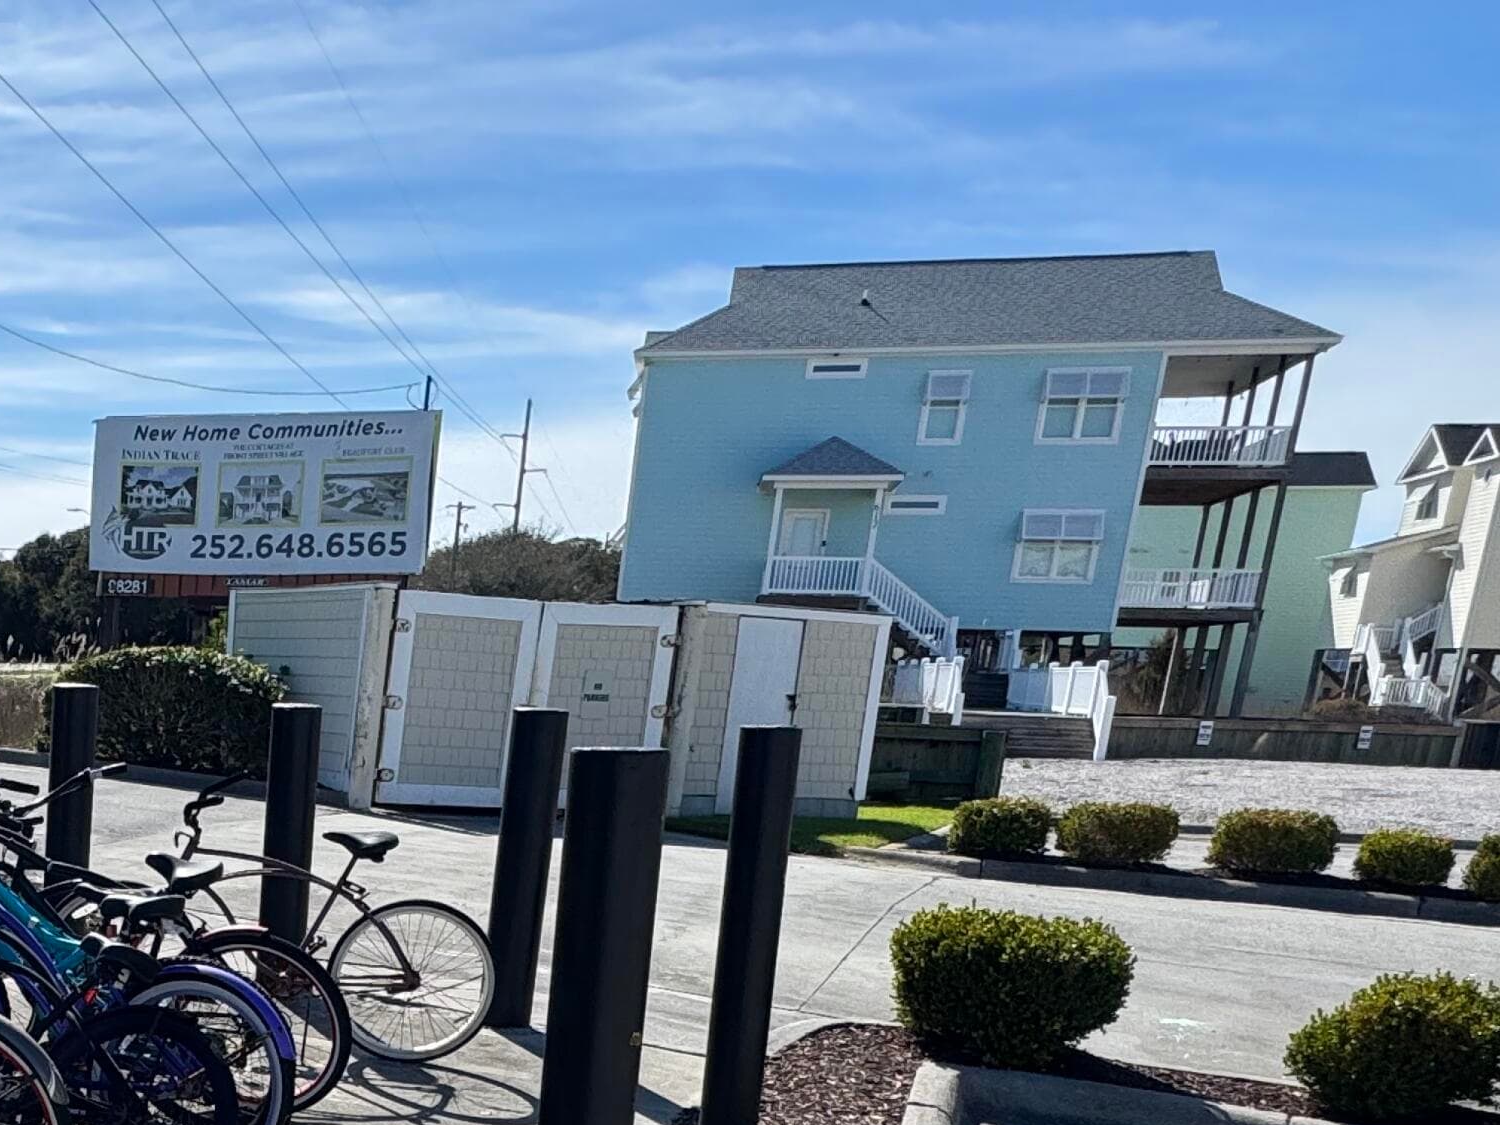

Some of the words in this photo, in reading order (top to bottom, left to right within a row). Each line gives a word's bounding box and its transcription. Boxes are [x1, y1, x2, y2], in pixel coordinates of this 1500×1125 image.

[133, 424, 177, 441] New
[182, 424, 240, 441] Home
[248, 418, 403, 440] Communities...
[121, 448, 160, 460] INDIAN
[163, 448, 201, 461] TRACE
[189, 531, 407, 560] 252.648.6565
